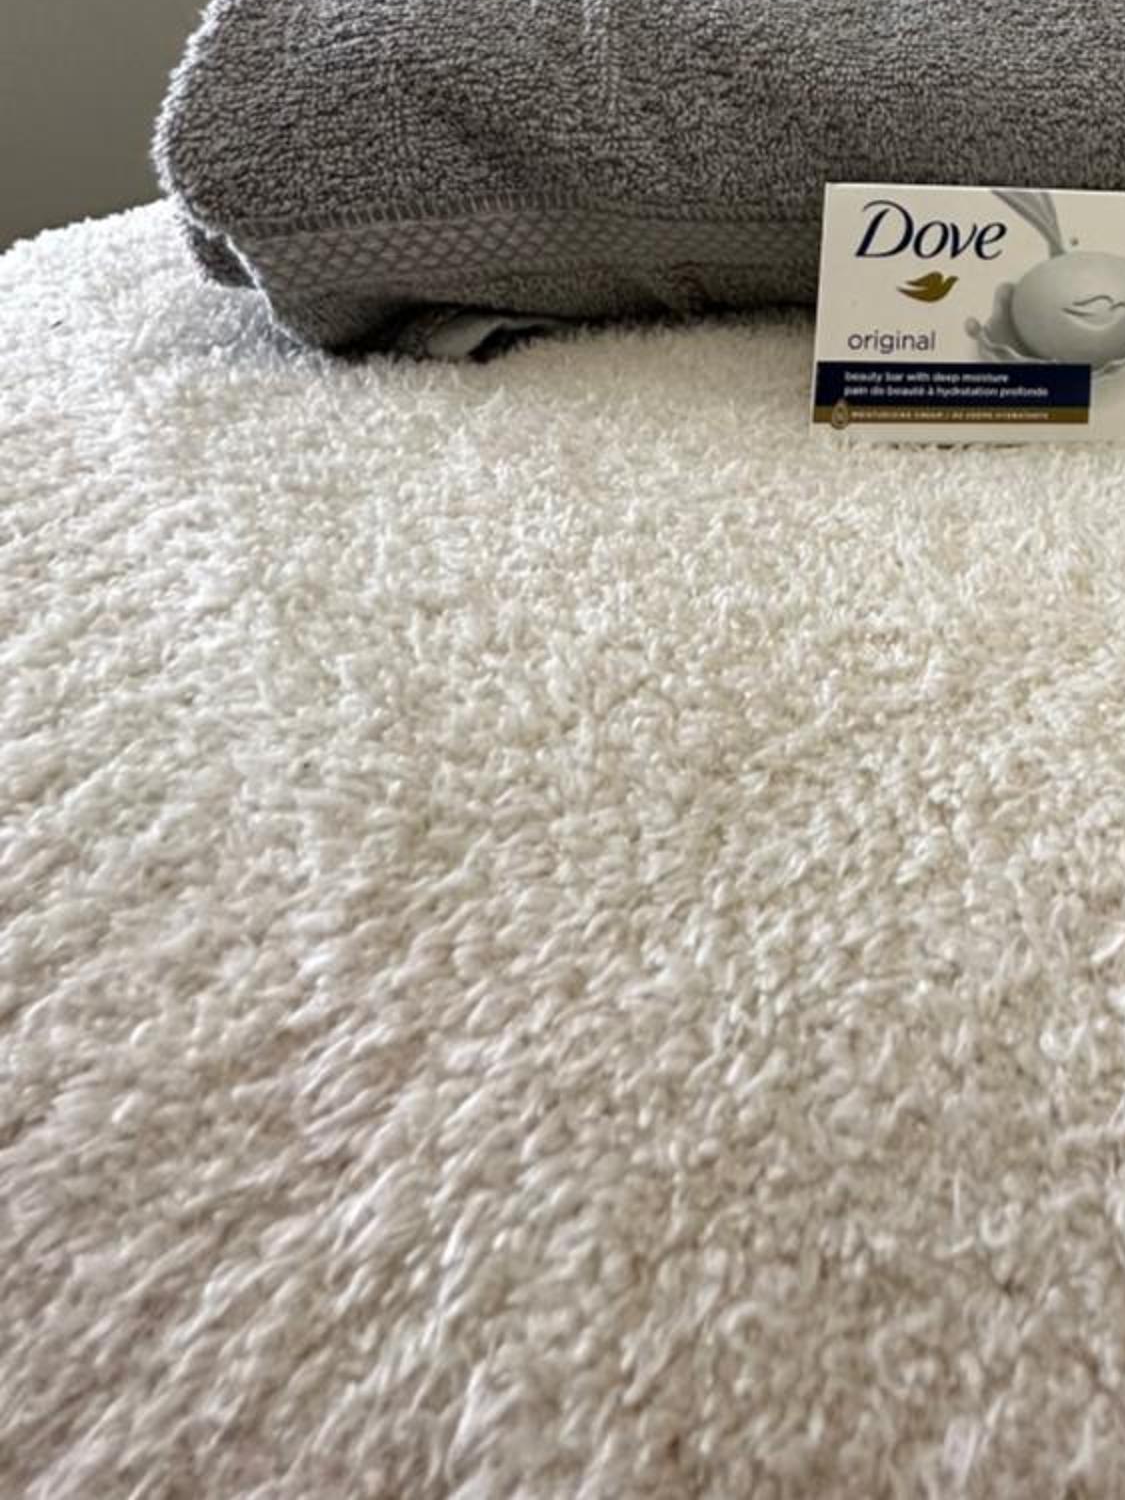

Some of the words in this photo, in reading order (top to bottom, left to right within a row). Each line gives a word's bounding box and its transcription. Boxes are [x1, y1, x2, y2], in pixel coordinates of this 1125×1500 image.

[855, 199, 1008, 260] Dove
[847, 329, 936, 354] original
[844, 371, 884, 384] beauty
[885, 371, 904, 382] bar
[906, 371, 930, 383] with
[932, 371, 960, 385] deep
[961, 372, 1009, 384] moisture
